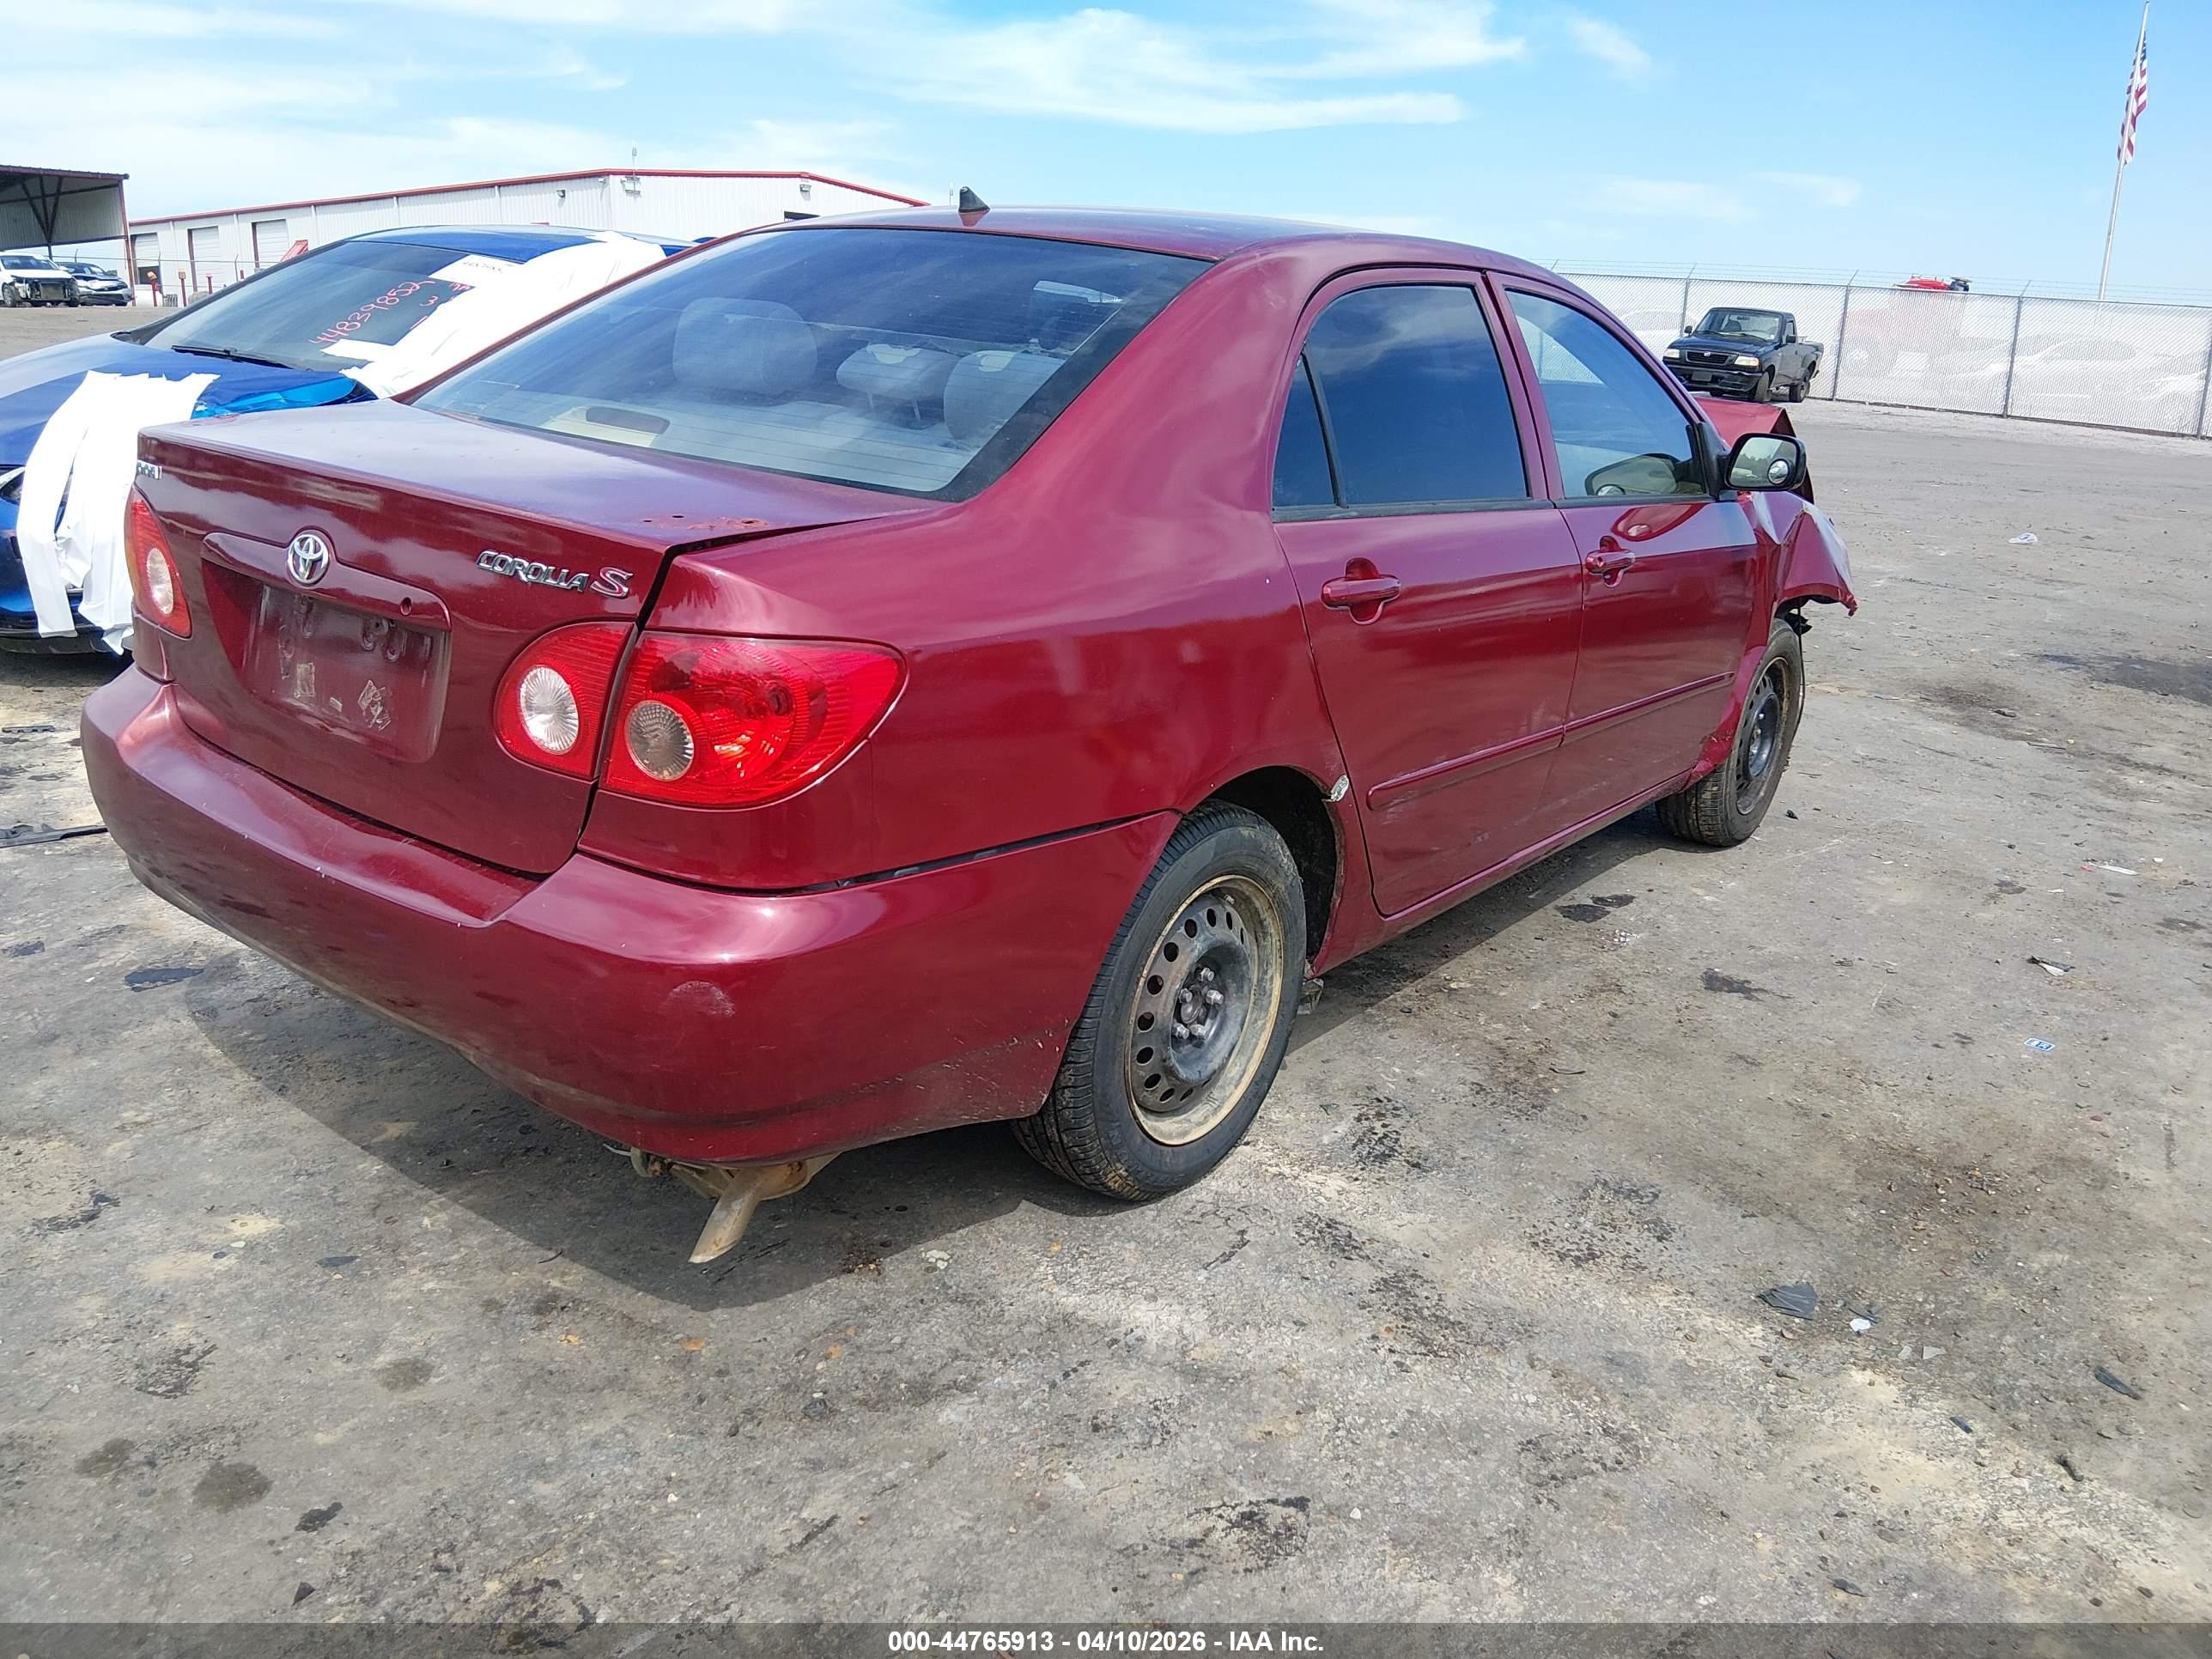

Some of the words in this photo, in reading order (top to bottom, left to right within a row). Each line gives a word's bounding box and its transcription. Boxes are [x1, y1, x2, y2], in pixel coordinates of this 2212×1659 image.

[308, 281, 436, 343] 44839852
[476, 550, 590, 592] COROLLA
[590, 567, 634, 598] S
